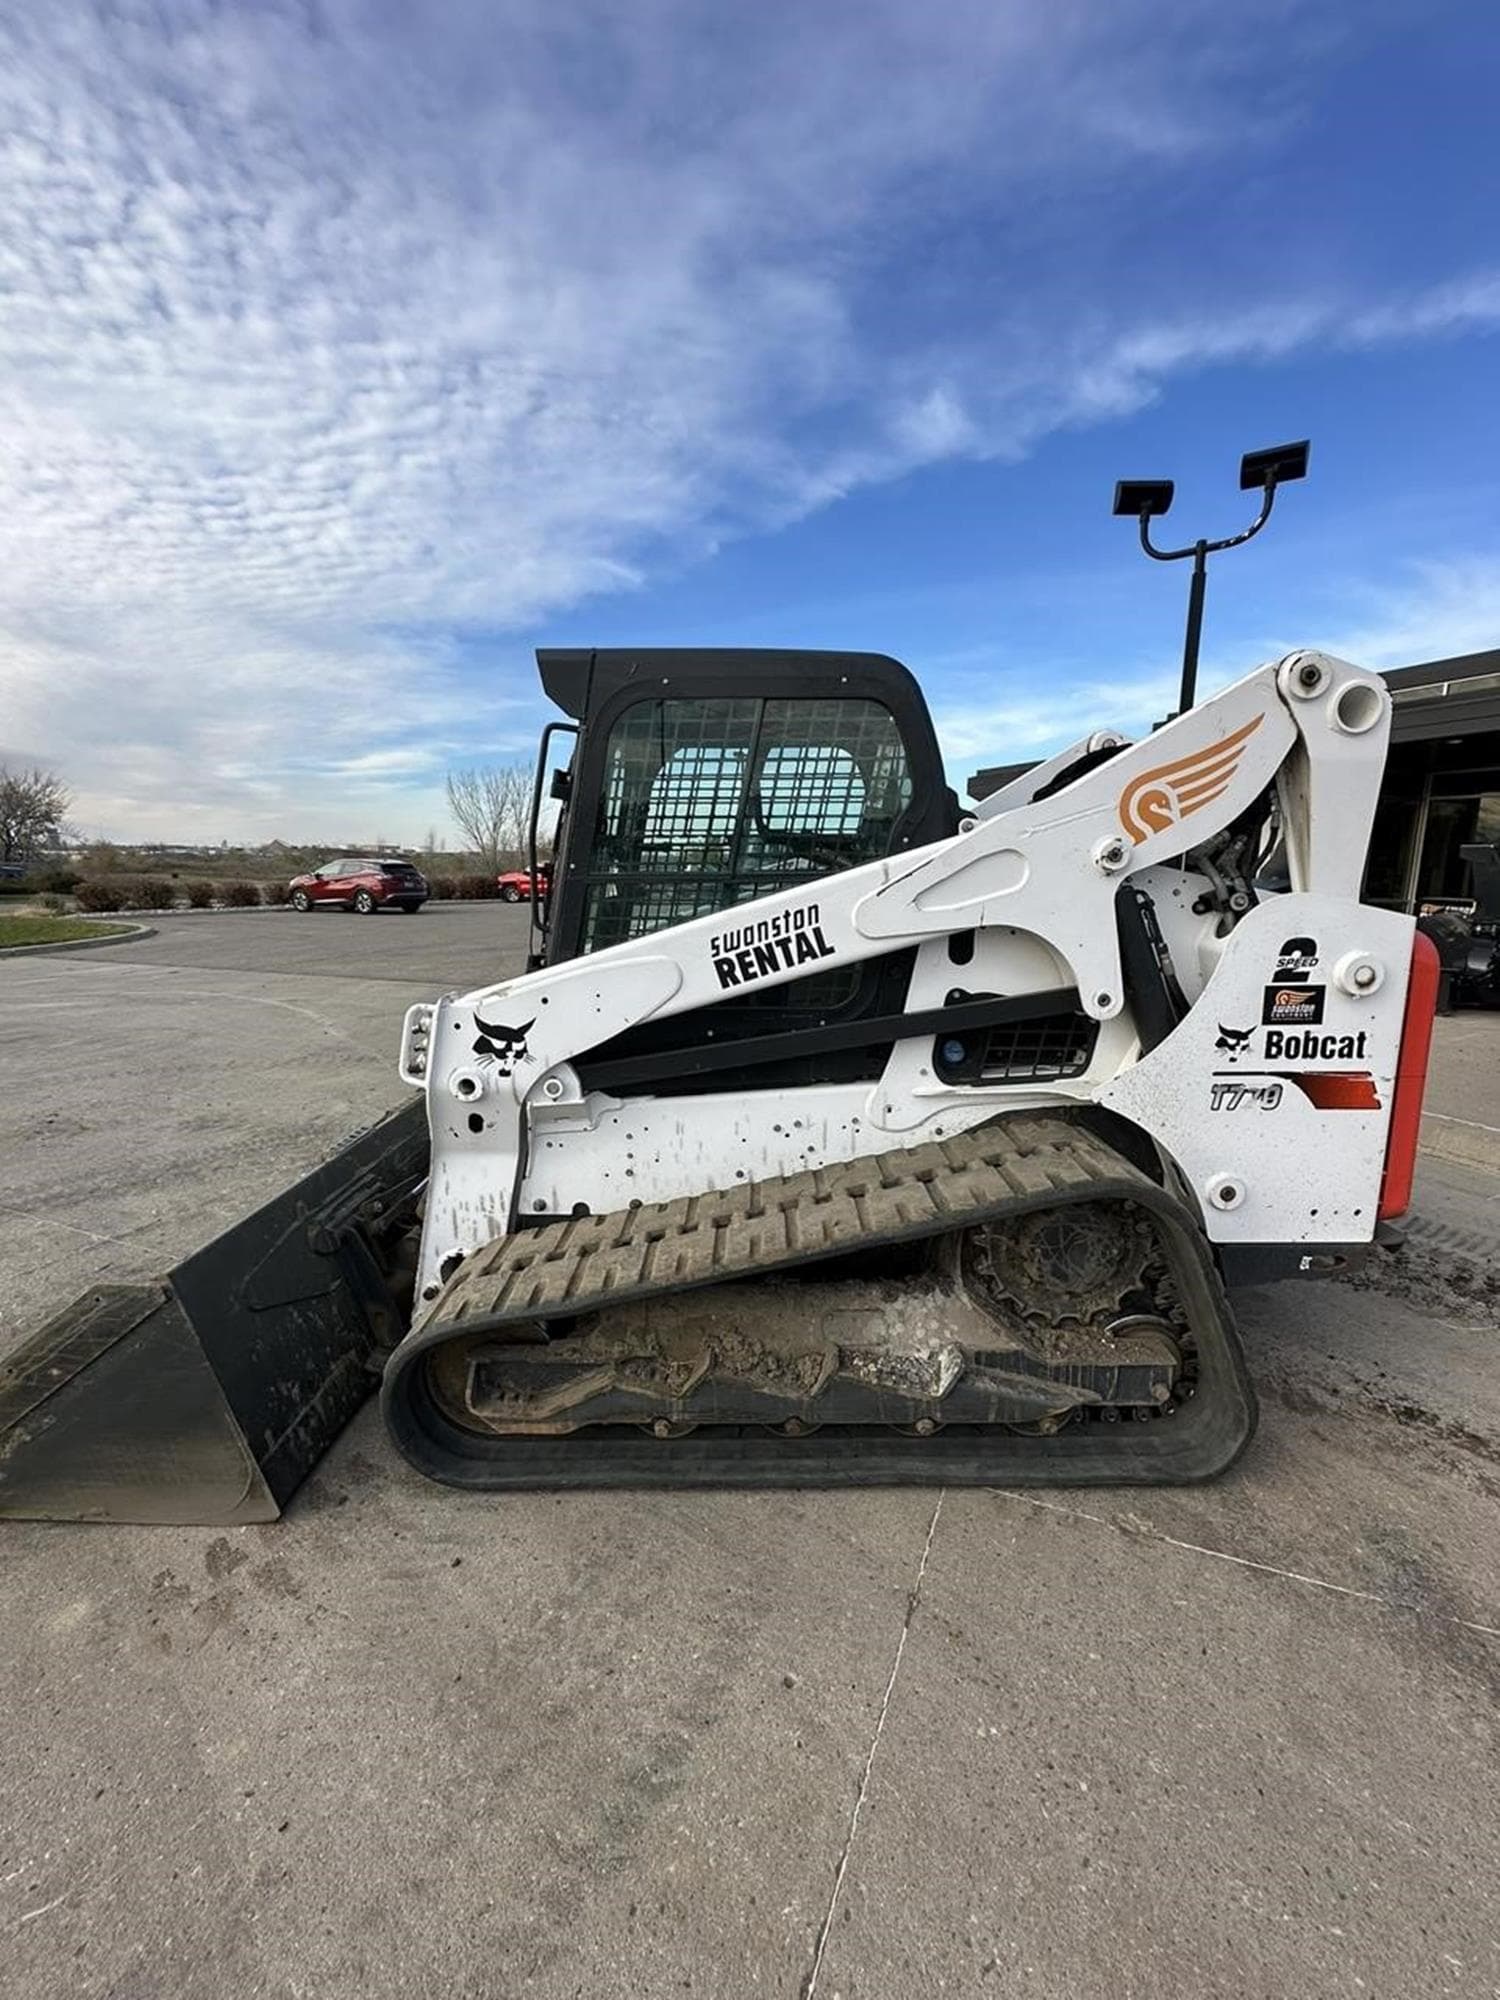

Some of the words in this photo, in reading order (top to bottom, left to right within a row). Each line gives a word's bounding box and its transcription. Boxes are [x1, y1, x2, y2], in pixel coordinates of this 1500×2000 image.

[710, 904, 819, 958] swanston
[713, 926, 836, 989] RENTAL
[1271, 937, 1318, 983] 2
[1276, 957, 1320, 968] SPEED
[1264, 1030, 1366, 1059] Bobcat
